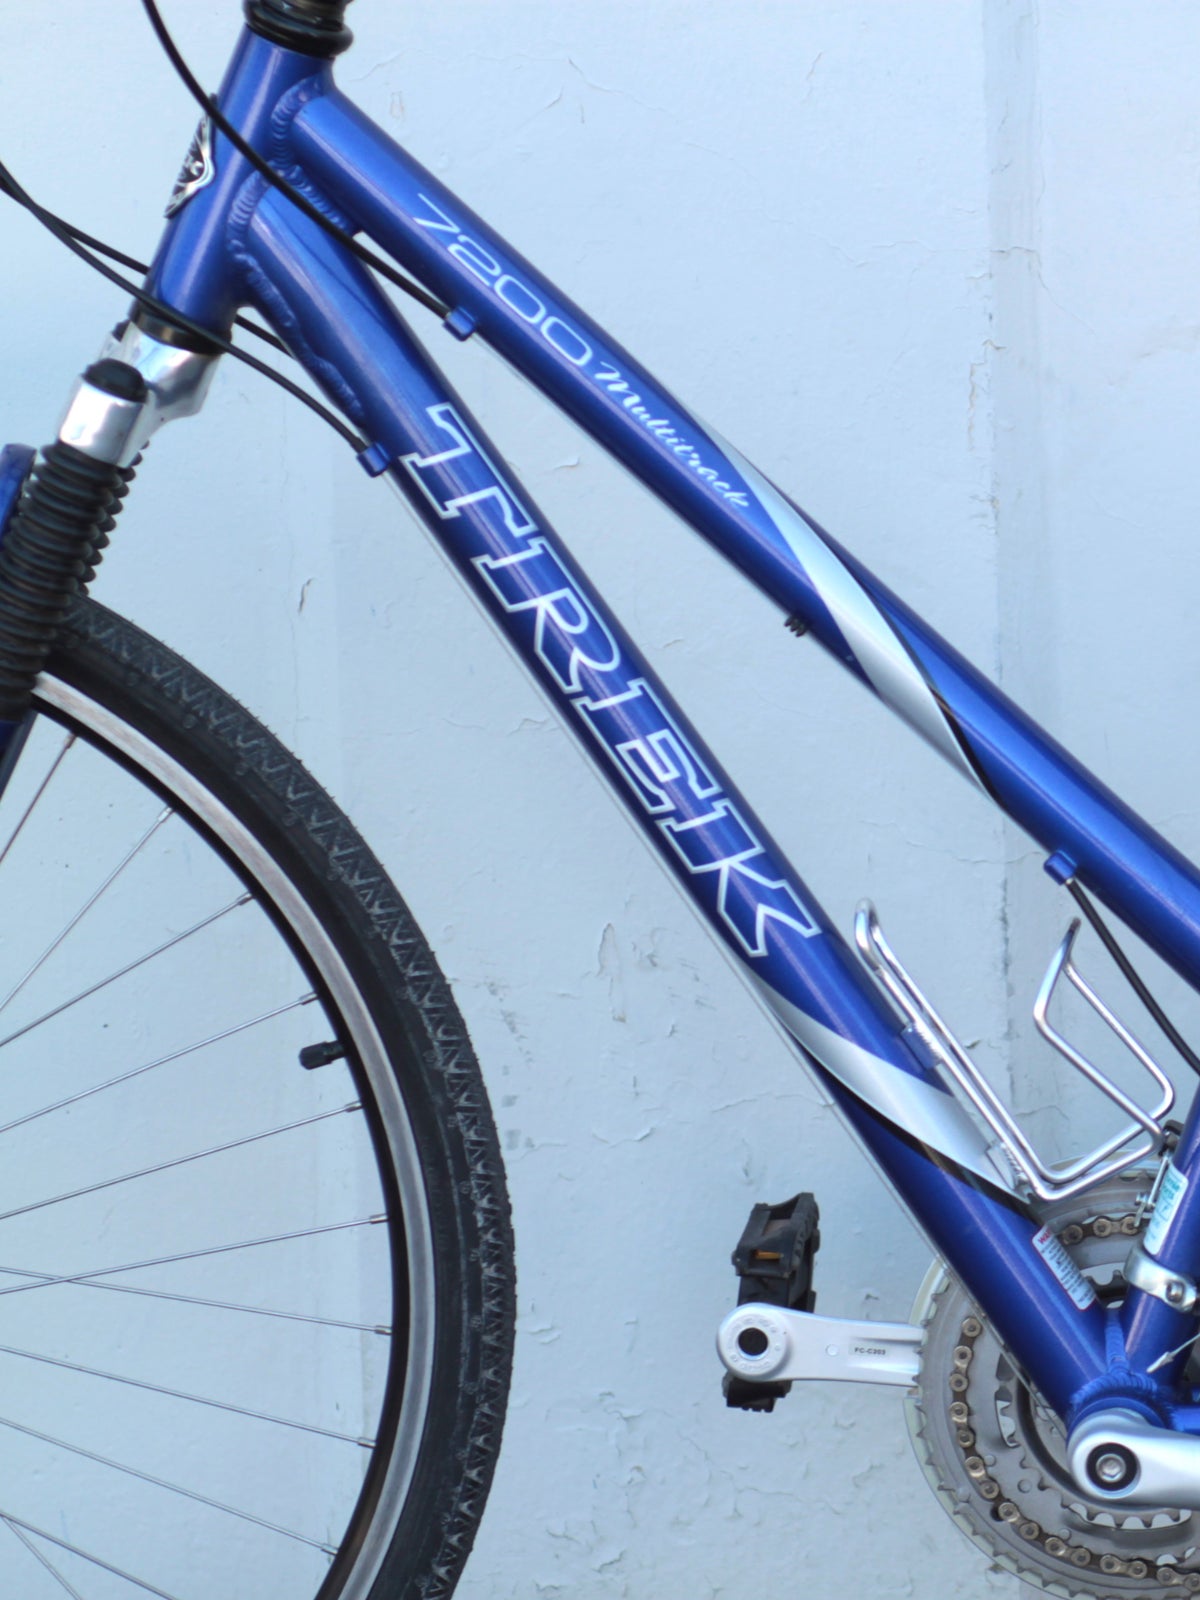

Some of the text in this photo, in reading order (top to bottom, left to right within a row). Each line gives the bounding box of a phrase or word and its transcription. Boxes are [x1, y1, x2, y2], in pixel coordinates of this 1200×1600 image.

[412, 192, 750, 507] 7200 Multitrack
[400, 402, 822, 957] TREK
